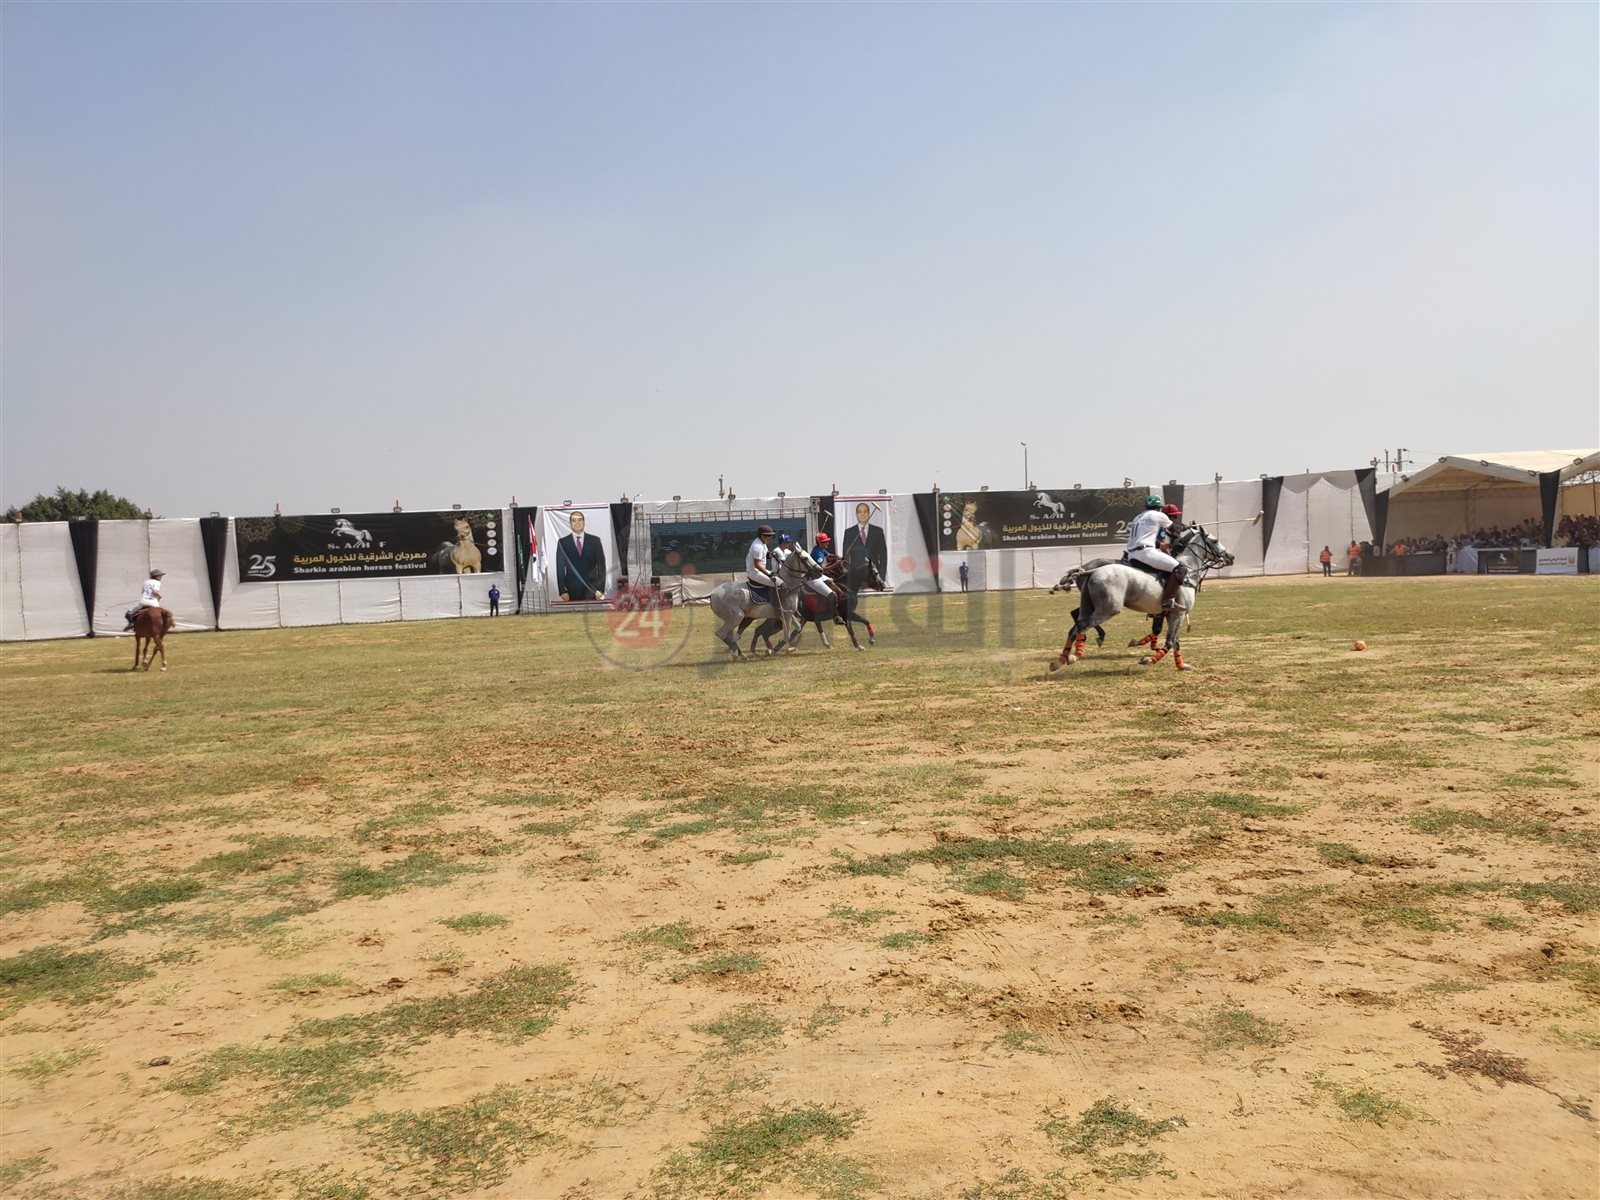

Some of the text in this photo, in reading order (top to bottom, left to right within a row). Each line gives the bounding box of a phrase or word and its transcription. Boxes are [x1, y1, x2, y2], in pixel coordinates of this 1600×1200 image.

[1002, 534, 1028, 542] Sharkia
[1029, 533, 1056, 541] arabian
[293, 550, 427, 565] مهرجان الشرقية للخيول العربية
[248, 554, 277, 577] 25
[293, 562, 427, 574] Sharkia arabian horses festival
